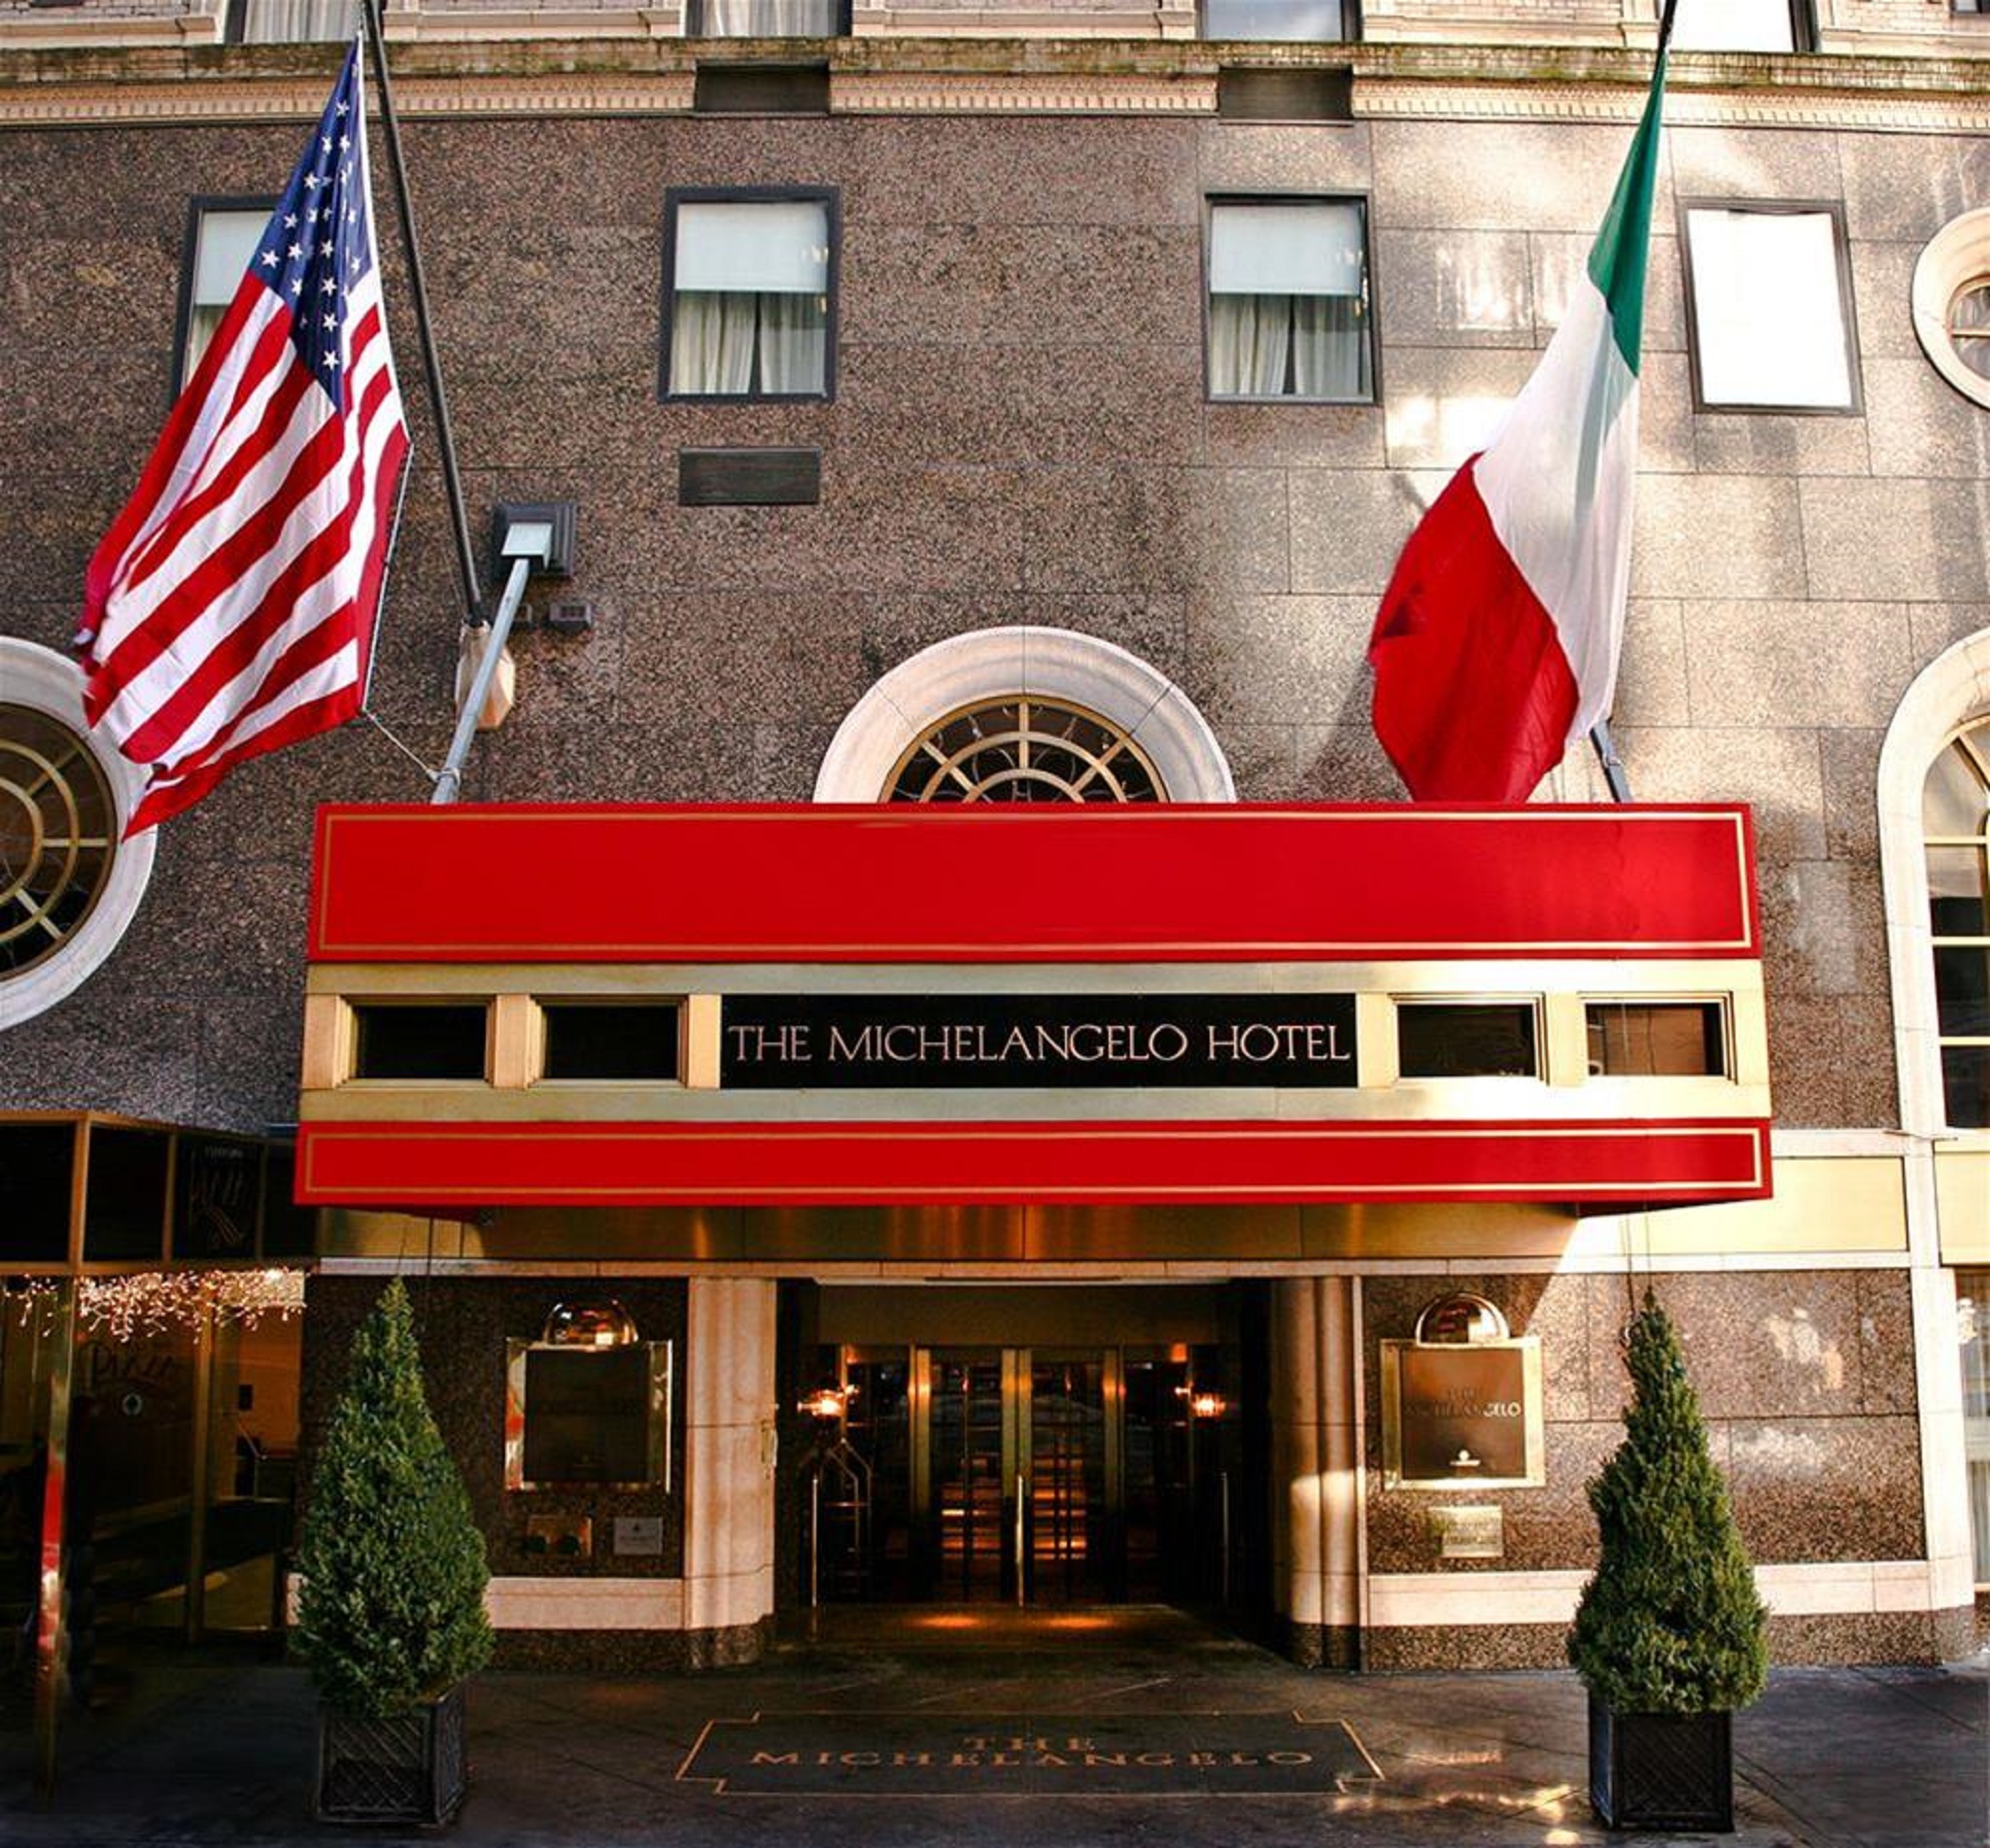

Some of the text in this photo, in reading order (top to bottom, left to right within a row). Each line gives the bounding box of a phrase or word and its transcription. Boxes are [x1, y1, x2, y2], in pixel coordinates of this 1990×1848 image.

[728, 1023, 1352, 1062] THE MICHELANGELO HOTEL
[963, 1737, 1096, 1750] THE
[751, 1751, 1313, 1766] MICHELANGELO
